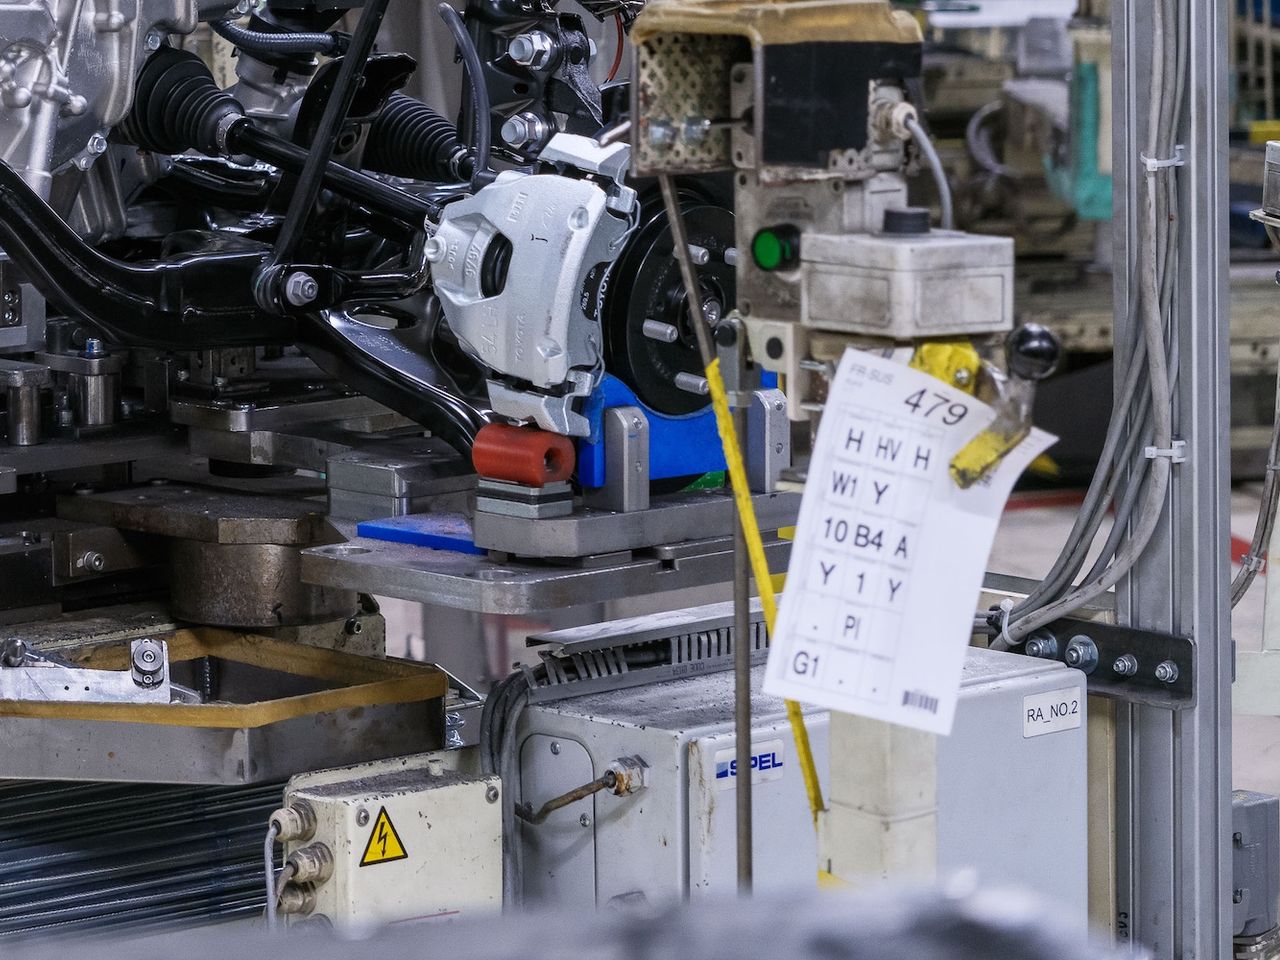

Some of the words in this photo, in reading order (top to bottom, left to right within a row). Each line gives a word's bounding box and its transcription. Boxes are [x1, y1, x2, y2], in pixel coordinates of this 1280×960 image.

[904, 387, 969, 427] 479
[845, 427, 865, 453] H
[875, 436, 903, 462] HV
[913, 445, 931, 471] H
[832, 470, 858, 499] W1
[873, 480, 890, 505] Y
[824, 517, 849, 543] 10
[853, 524, 884, 551] B4
[894, 534, 908, 560] A
[820, 560, 837, 586] Y
[856, 571, 866, 595] 1
[888, 578, 903, 603] Y
[792, 650, 819, 678] G1
[1027, 700, 1079, 724] RA_NO.2
